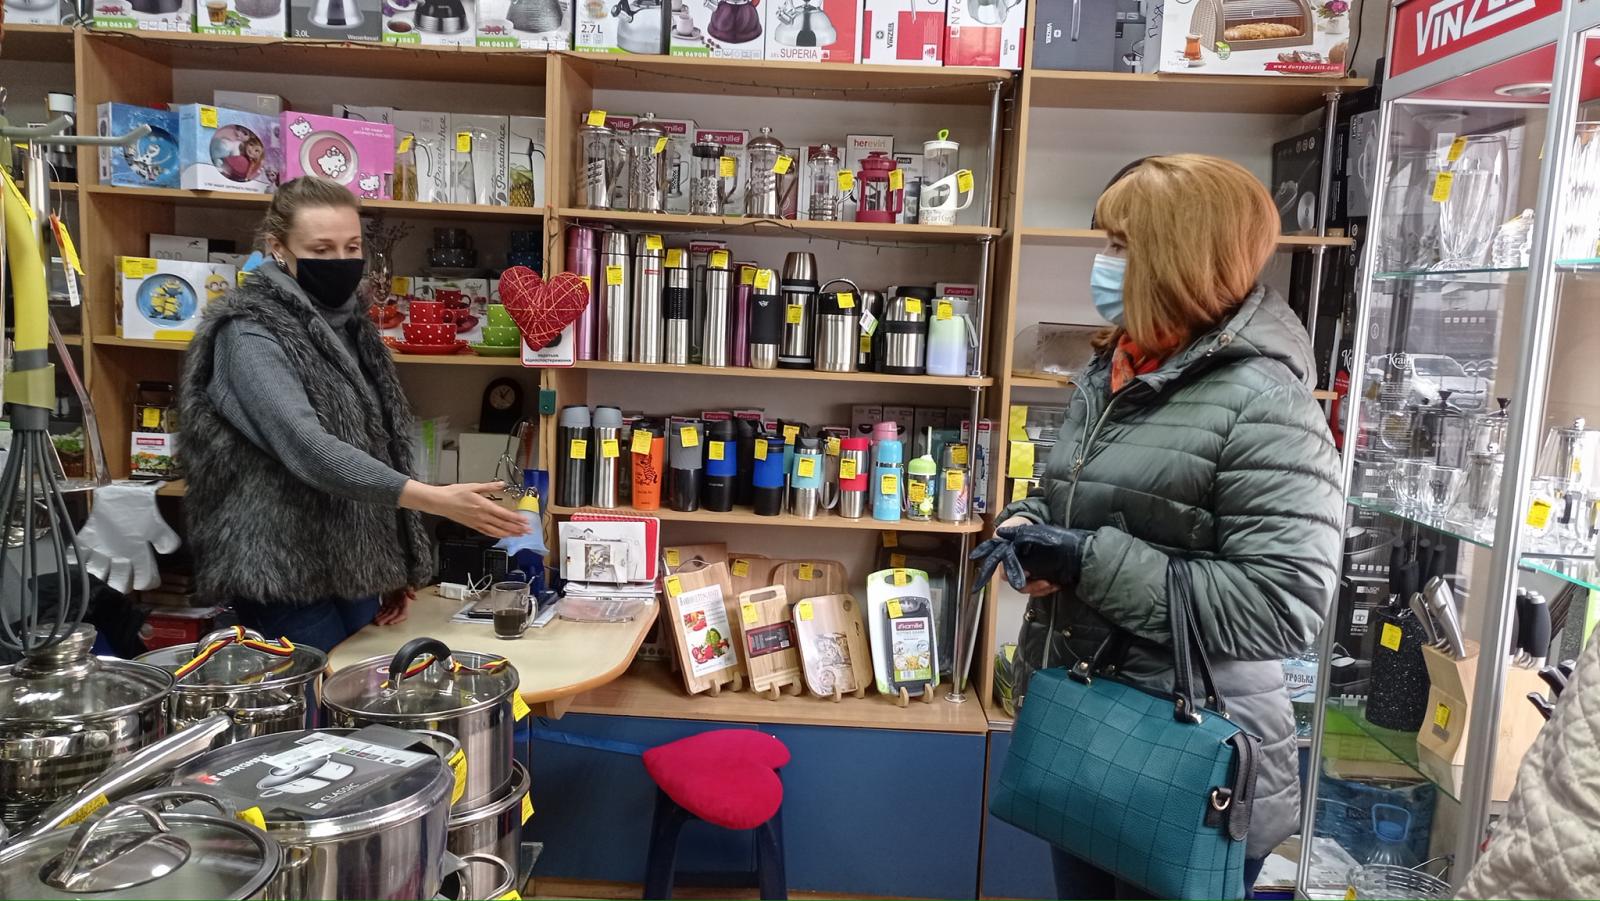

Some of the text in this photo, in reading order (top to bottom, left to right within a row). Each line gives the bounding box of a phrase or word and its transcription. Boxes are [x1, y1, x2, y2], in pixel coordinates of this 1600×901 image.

[295, 30, 310, 38] 3.0L
[581, 24, 604, 34] 2.7 L
[780, 48, 818, 59] SUPERIA
[854, 139, 886, 148] herevin
[320, 783, 360, 801] CLASSIC
